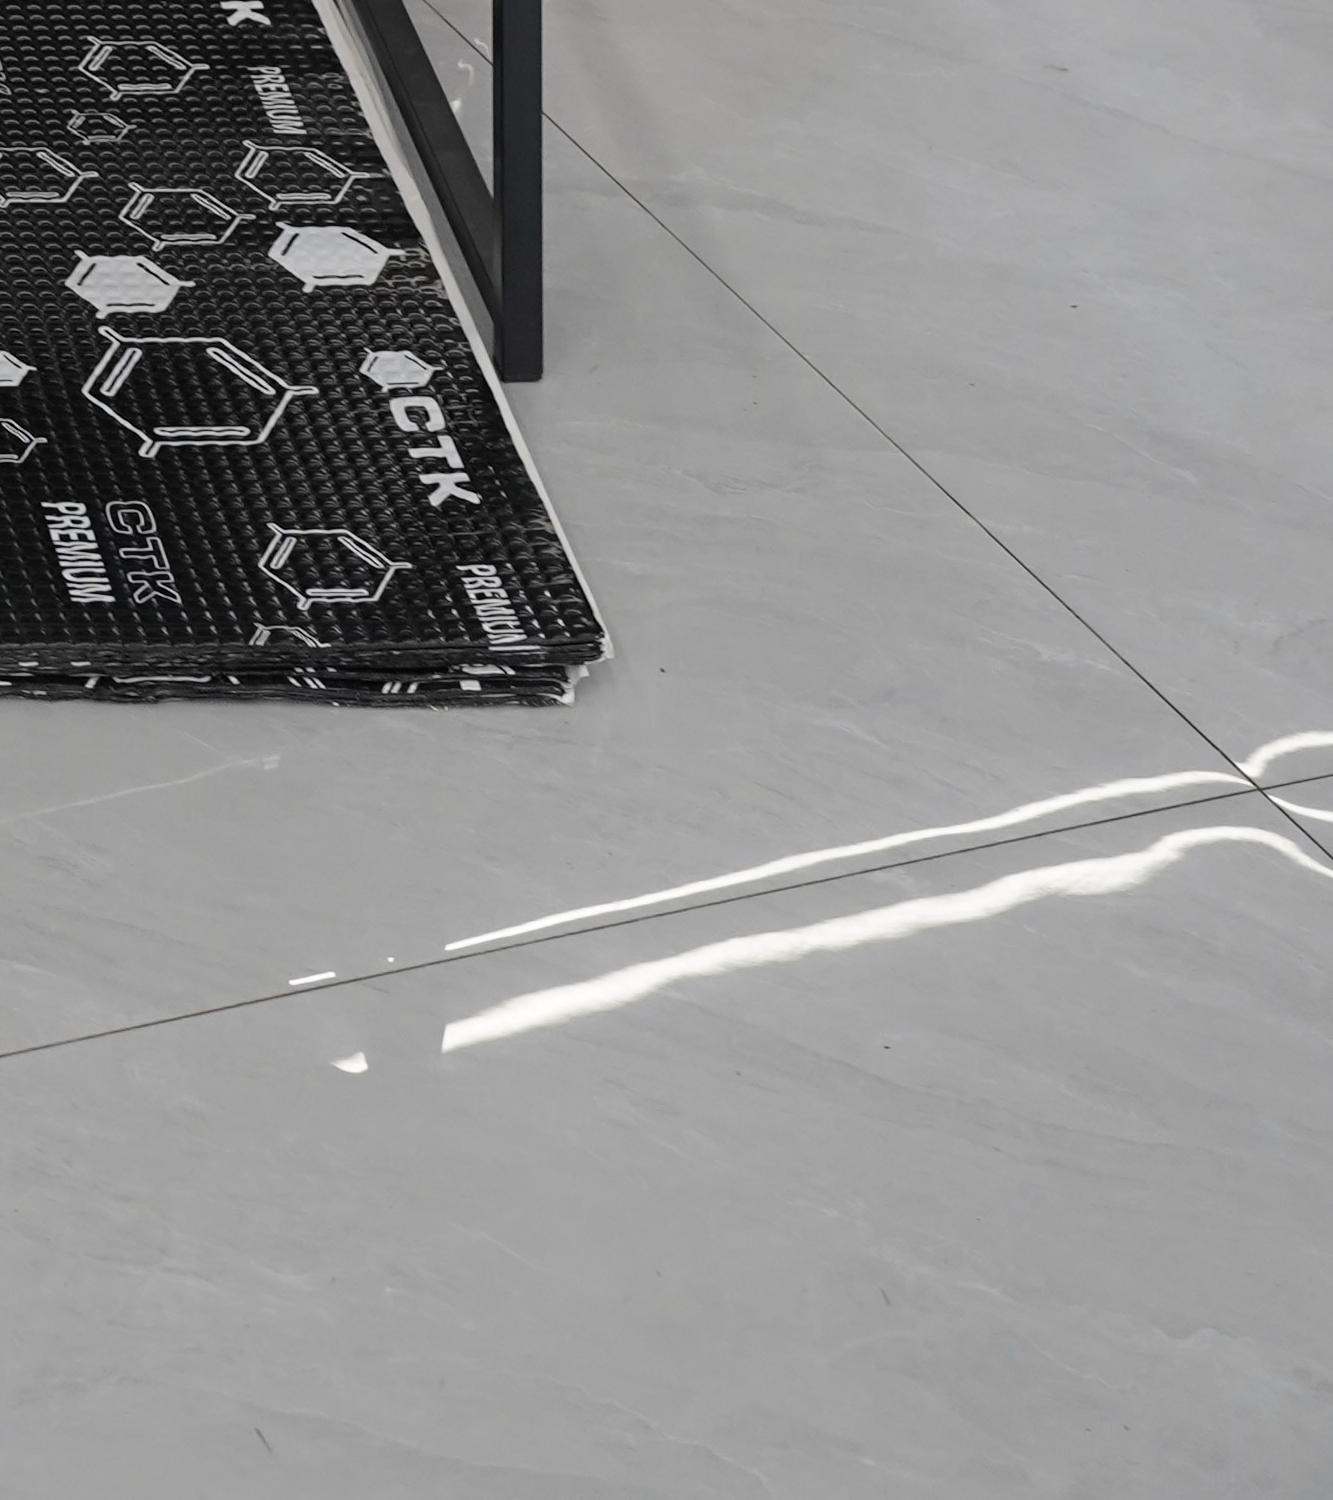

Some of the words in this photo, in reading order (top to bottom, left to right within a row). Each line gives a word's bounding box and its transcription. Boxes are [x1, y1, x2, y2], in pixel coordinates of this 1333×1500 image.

[247, 66, 308, 136] PREMIUM
[388, 396, 483, 509] CTK
[41, 501, 116, 605] PREMIUM
[104, 499, 183, 608] CTK
